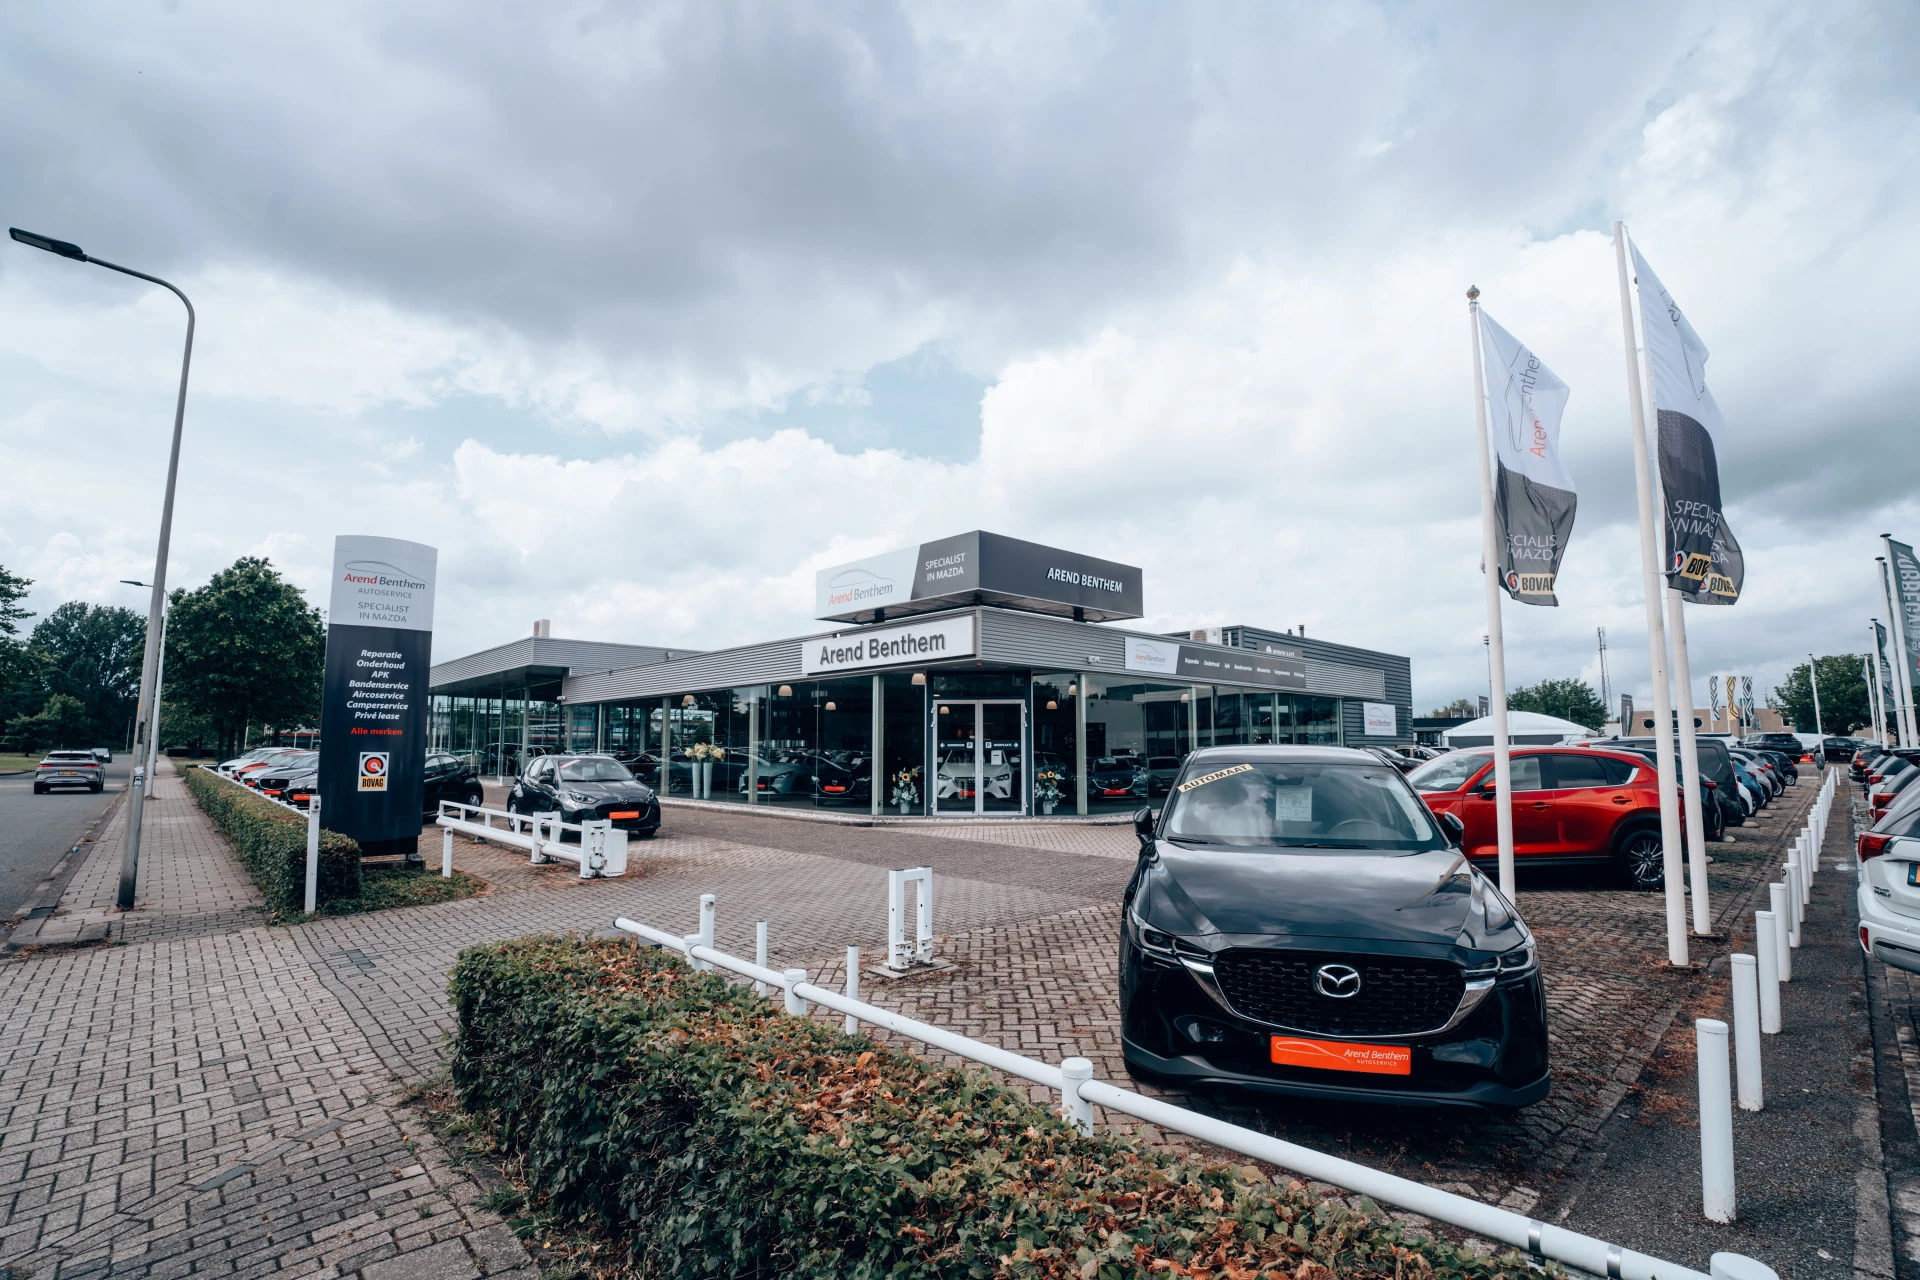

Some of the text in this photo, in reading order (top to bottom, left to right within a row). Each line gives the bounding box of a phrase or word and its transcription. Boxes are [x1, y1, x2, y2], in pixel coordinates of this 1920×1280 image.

[925, 552, 966, 571] SPECIALIST
[926, 566, 964, 582] IN MAZDA
[1046, 567, 1123, 593] AREND BENTHEM
[344, 573, 426, 590] Arend Benthem
[357, 587, 413, 599] AUTOSERVICE
[828, 583, 893, 606] Arend Benthem
[358, 601, 410, 613] SPECIALIST
[359, 611, 407, 623] IN MAZDA
[360, 649, 402, 659] Reparatie
[820, 633, 946, 665] Arend Benthem
[356, 659, 406, 670] Onderhoud
[371, 670, 390, 679] APK
[348, 679, 409, 690] Bandenservice
[352, 690, 405, 700] Aircoservice
[346, 700, 409, 710] Camperservice
[354, 711, 400, 720] Privé lease
[350, 727, 403, 736] Alle merken
[362, 778, 384, 788] BOVAG
[1183, 765, 1248, 791] AUTOMAAT
[1343, 1048, 1409, 1061] Arend Benthem
[1357, 1059, 1398, 1067] AUTOSERVICE
